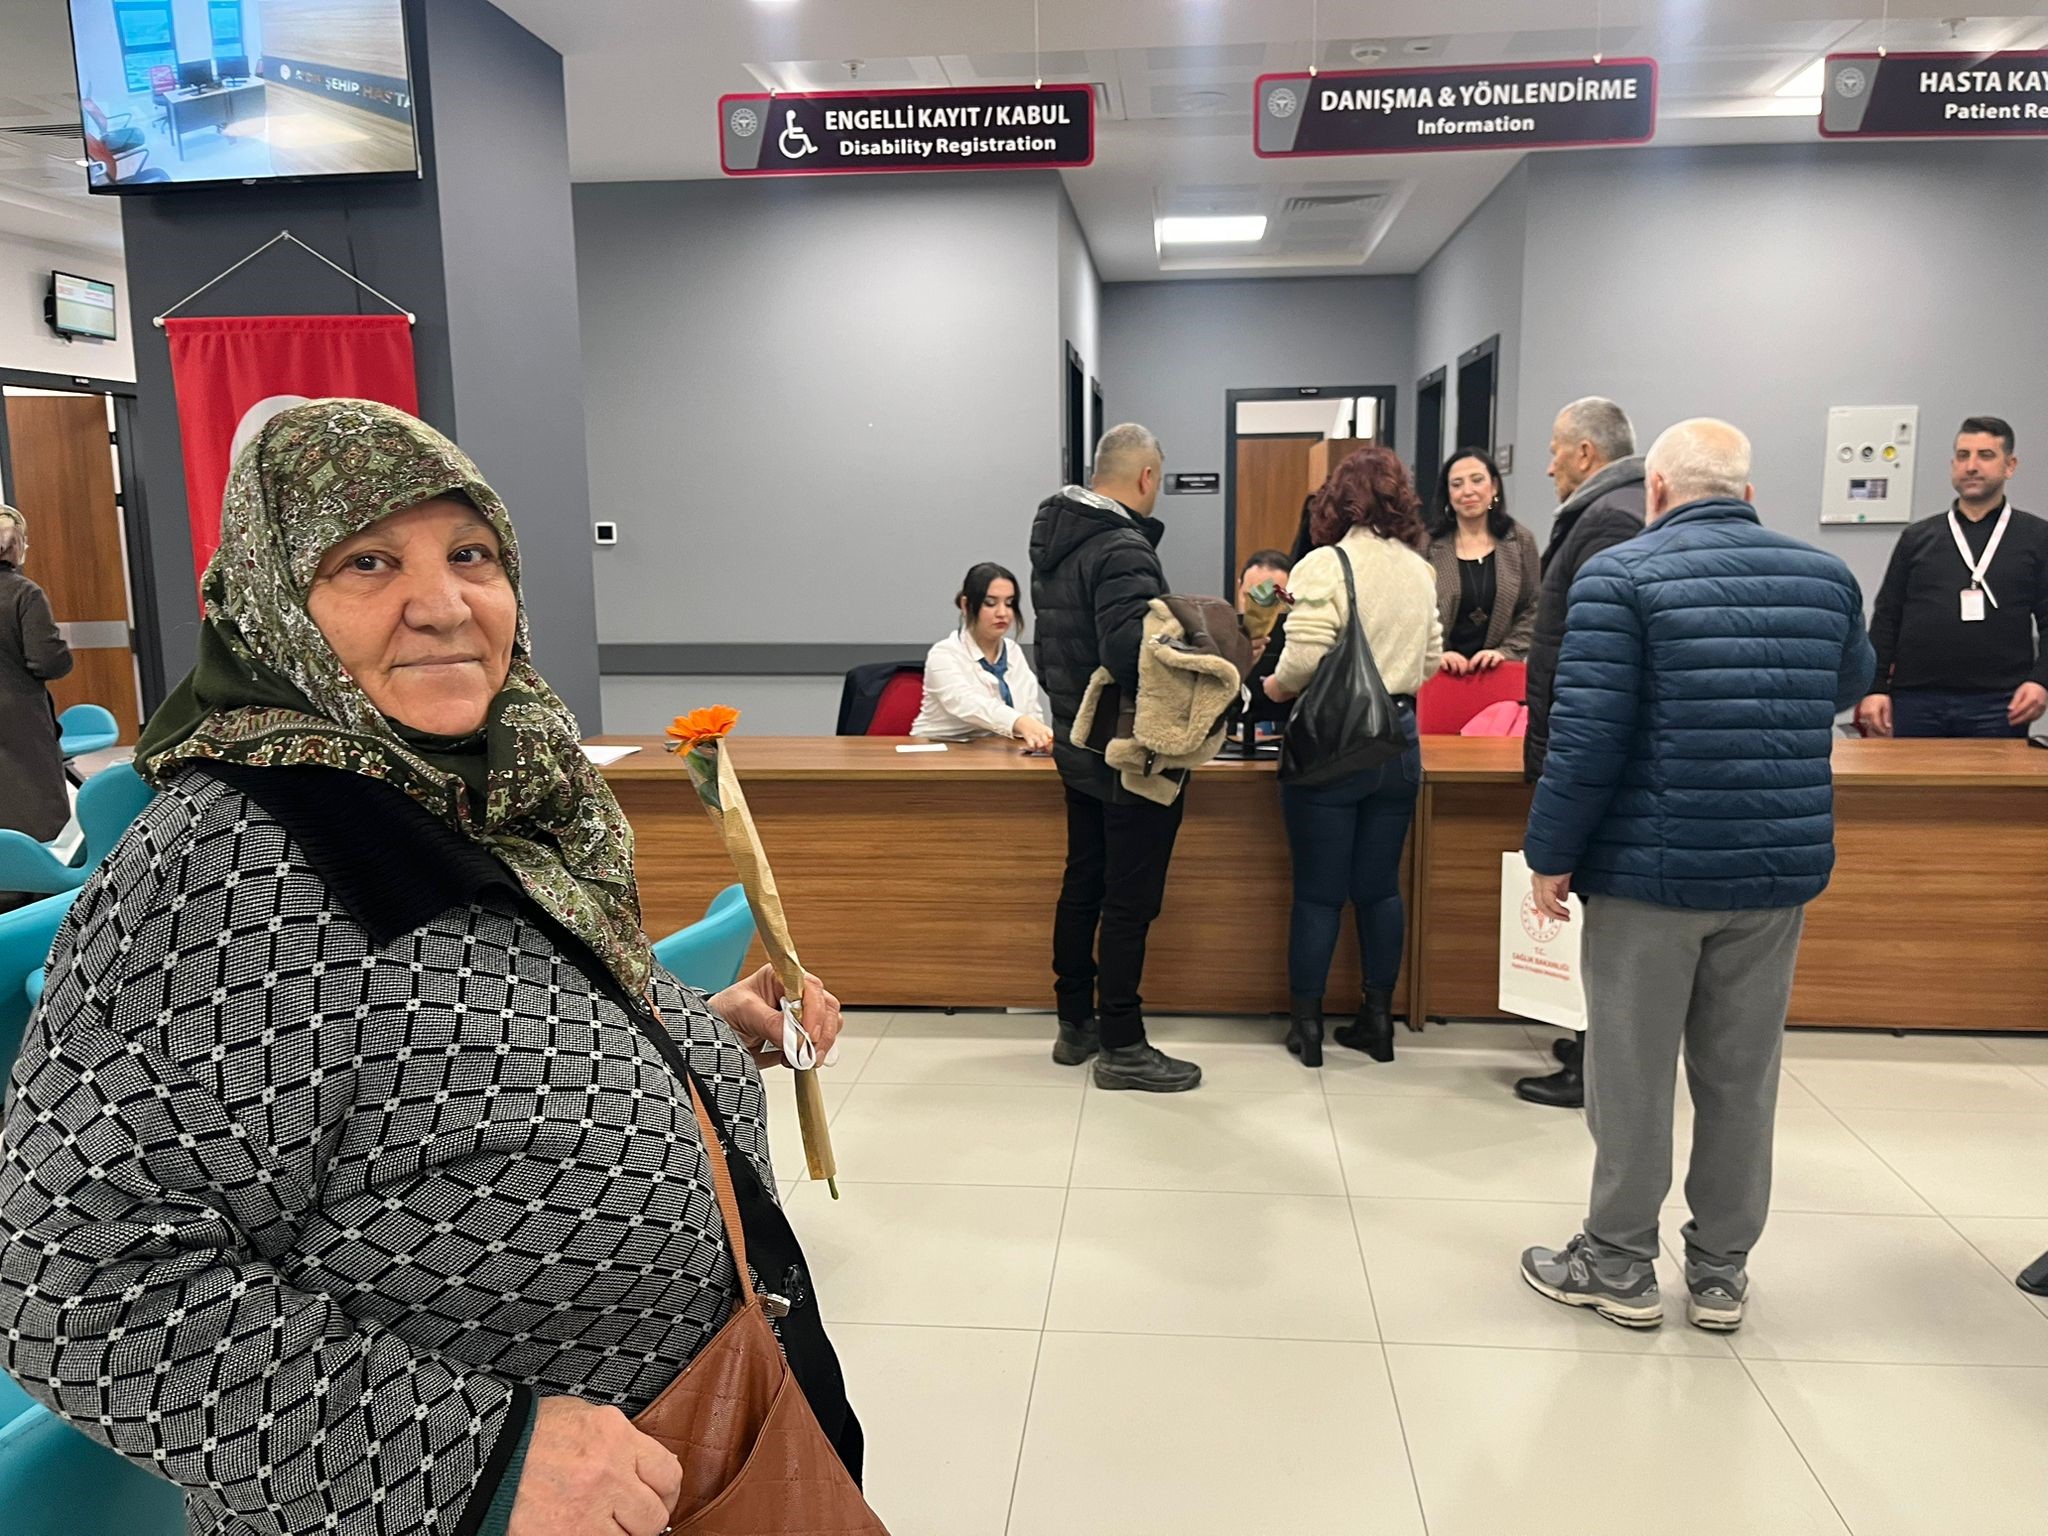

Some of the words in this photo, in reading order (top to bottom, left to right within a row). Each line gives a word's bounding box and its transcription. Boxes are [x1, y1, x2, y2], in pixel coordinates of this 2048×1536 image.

[1920, 71, 2003, 93] HASTA
[1320, 86, 1434, 114] DANIŞMA
[1437, 88, 1456, 108] &
[1460, 76, 1638, 107] YÖNLENDİRME
[824, 104, 914, 131] ENGELLİ
[918, 106, 981, 128] KAYIT
[996, 104, 1071, 126] KABUL
[1944, 102, 2021, 119] Patient
[1417, 115, 1535, 135] Information
[839, 138, 933, 158] Disability
[936, 136, 1057, 157] Registration
